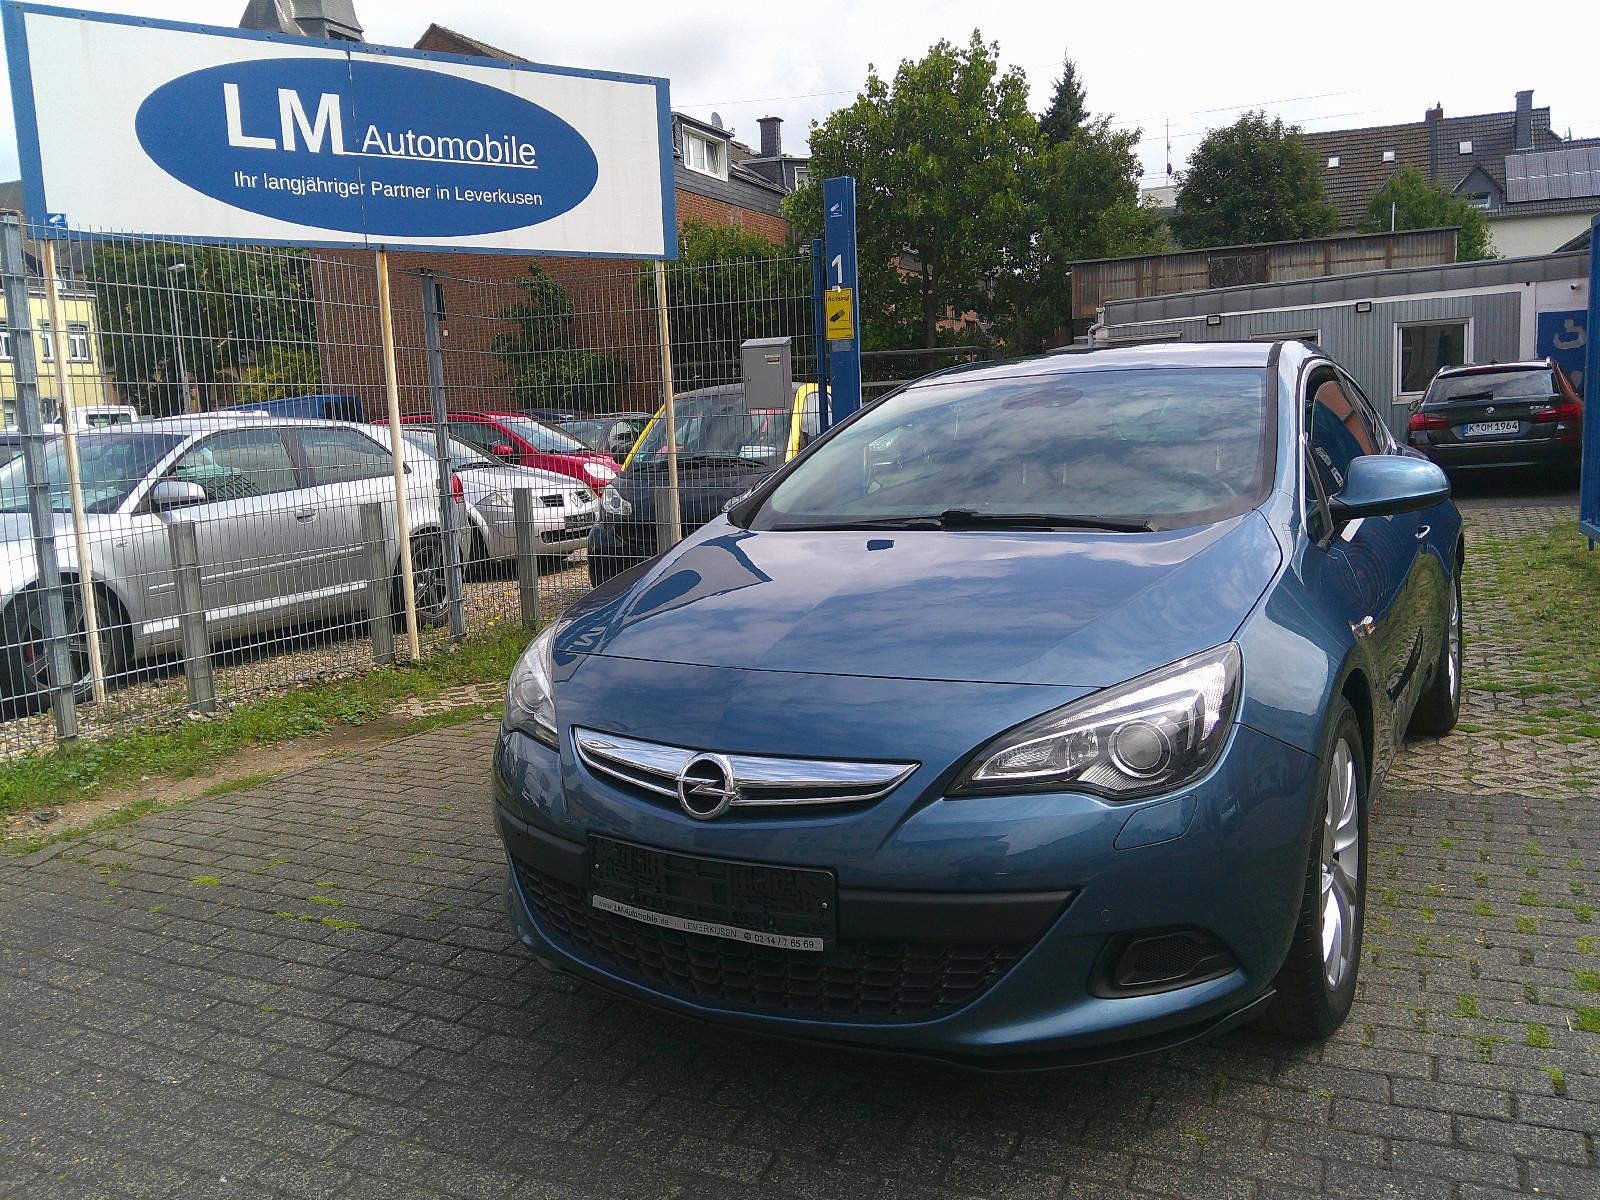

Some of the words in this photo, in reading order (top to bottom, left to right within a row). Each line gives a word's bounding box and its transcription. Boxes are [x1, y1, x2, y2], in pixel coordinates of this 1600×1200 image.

[223, 82, 344, 155] LM
[361, 124, 537, 165] Automobile
[234, 171, 258, 188] Ihr
[263, 173, 366, 198] langjähriger
[371, 181, 431, 200] Partner
[436, 184, 450, 200] in
[454, 186, 543, 206] Leverkusen
[831, 253, 843, 284] 1
[683, 922, 737, 938] LEVERKUSEN
[803, 940, 814, 949] 69
